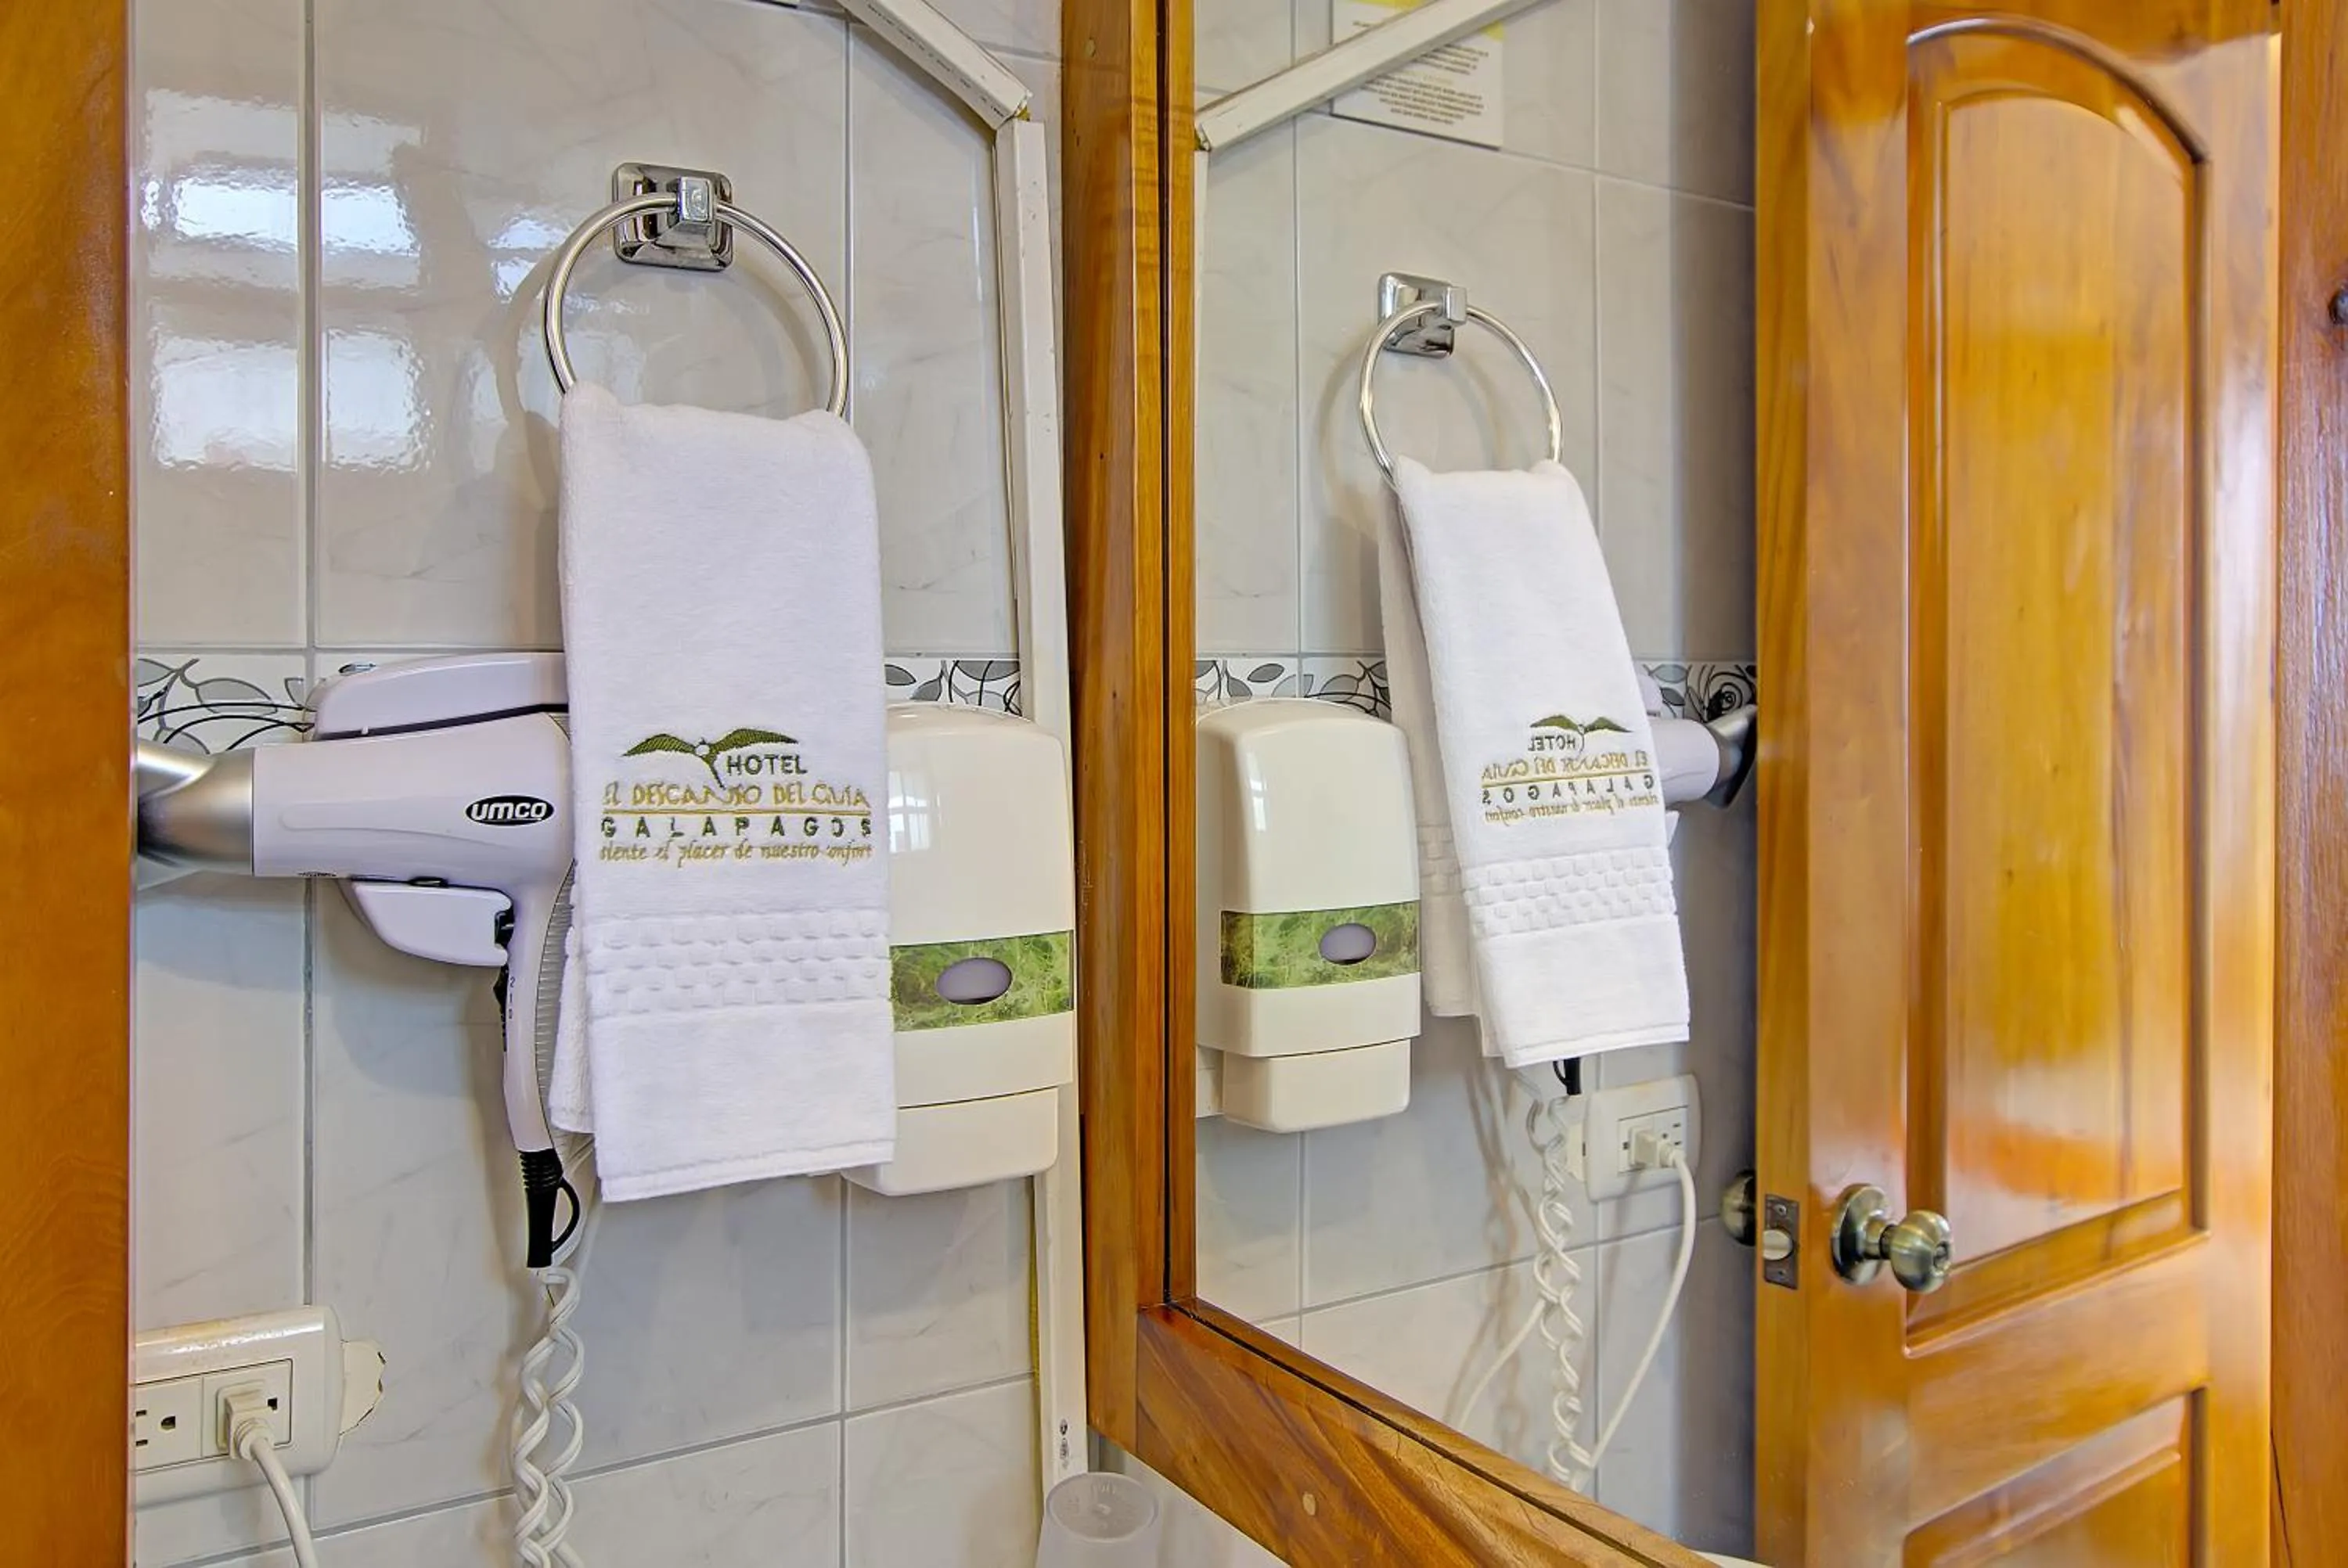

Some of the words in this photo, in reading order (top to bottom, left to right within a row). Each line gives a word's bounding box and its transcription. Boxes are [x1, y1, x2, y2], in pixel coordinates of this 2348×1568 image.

[726, 753, 808, 775] HOTEL
[600, 815, 872, 838] GALAPAGOS
[732, 838, 753, 860] de
[759, 842, 820, 860] nuestro
